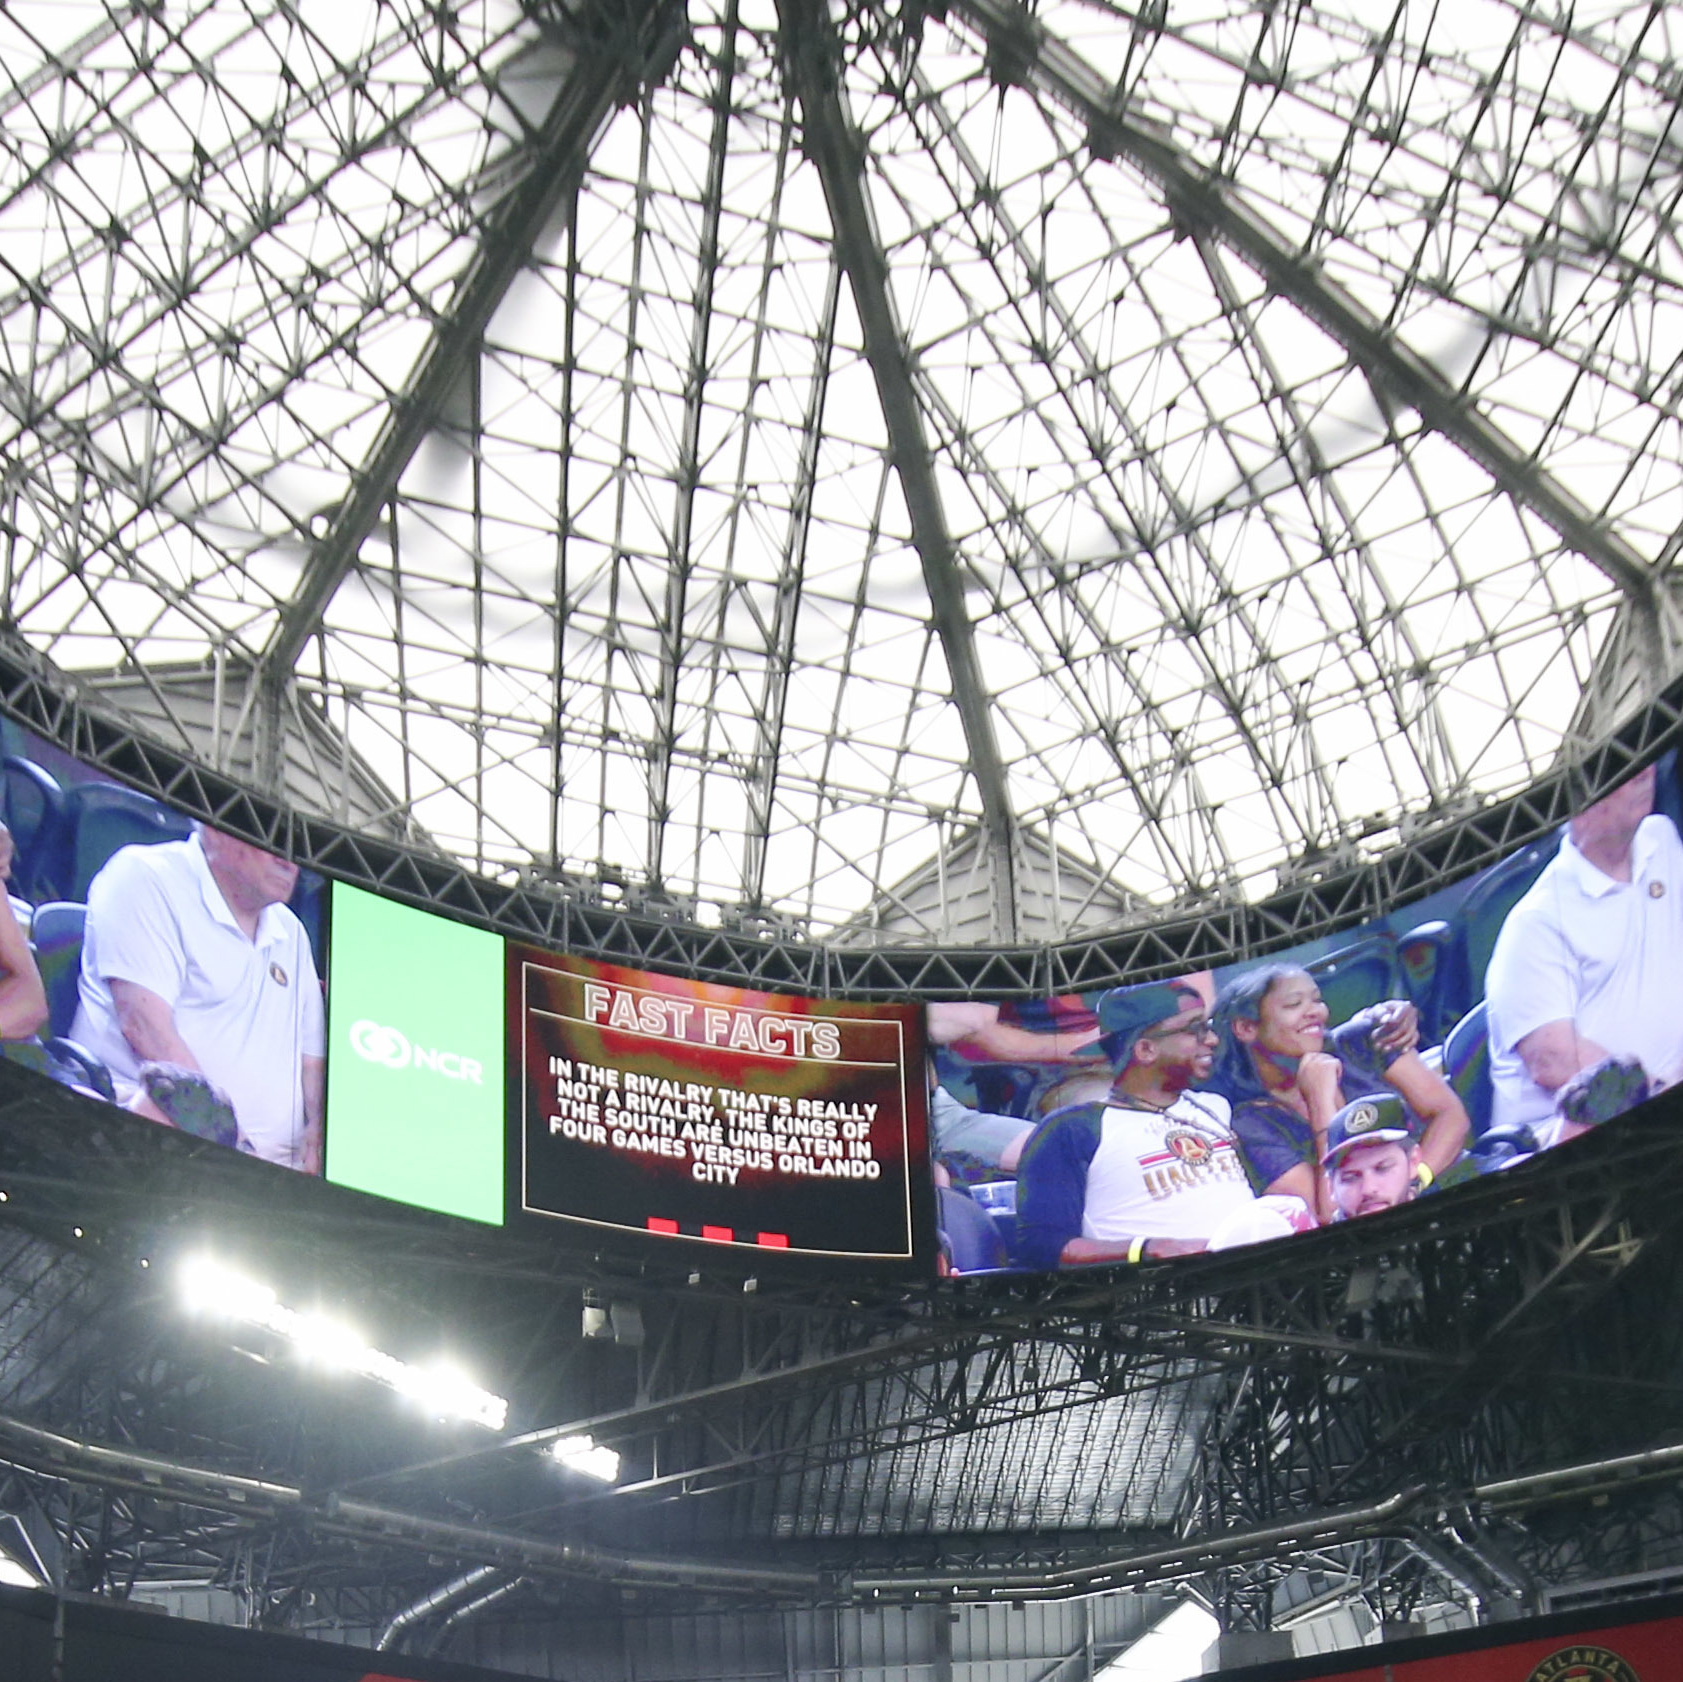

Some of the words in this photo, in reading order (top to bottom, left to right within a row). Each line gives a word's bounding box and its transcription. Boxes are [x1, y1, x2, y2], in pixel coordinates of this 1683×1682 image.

[583, 983, 693, 1039] FAST
[704, 1006, 841, 1060] FACTS
[413, 1046, 483, 1086] NCR
[549, 1056, 573, 1079] IN
[576, 1062, 619, 1088] THE
[624, 1072, 713, 1104] RIVALRY
[717, 1088, 792, 1115] THAT'S
[797, 1099, 878, 1122] REALLY
[557, 1079, 601, 1102] NOT
[605, 1089, 621, 1108] A
[626, 1092, 721, 1127] RIVALRY,
[725, 1108, 767, 1131] THE
[772, 1116, 838, 1137] KINGS
[843, 1122, 871, 1140] OF
[558, 1097, 600, 1123] THE
[604, 1108, 677, 1138] SOUTH
[680, 1124, 724, 1145] ARE
[729, 1128, 844, 1158] UNBEATEN
[849, 1141, 873, 1159] IN
[549, 1115, 608, 1144] FOUR
[612, 1128, 687, 1159] GAMES
[690, 1141, 775, 1171] VERSUS
[778, 1155, 881, 1181] ORLANDO
[692, 1161, 741, 1186] CITY
